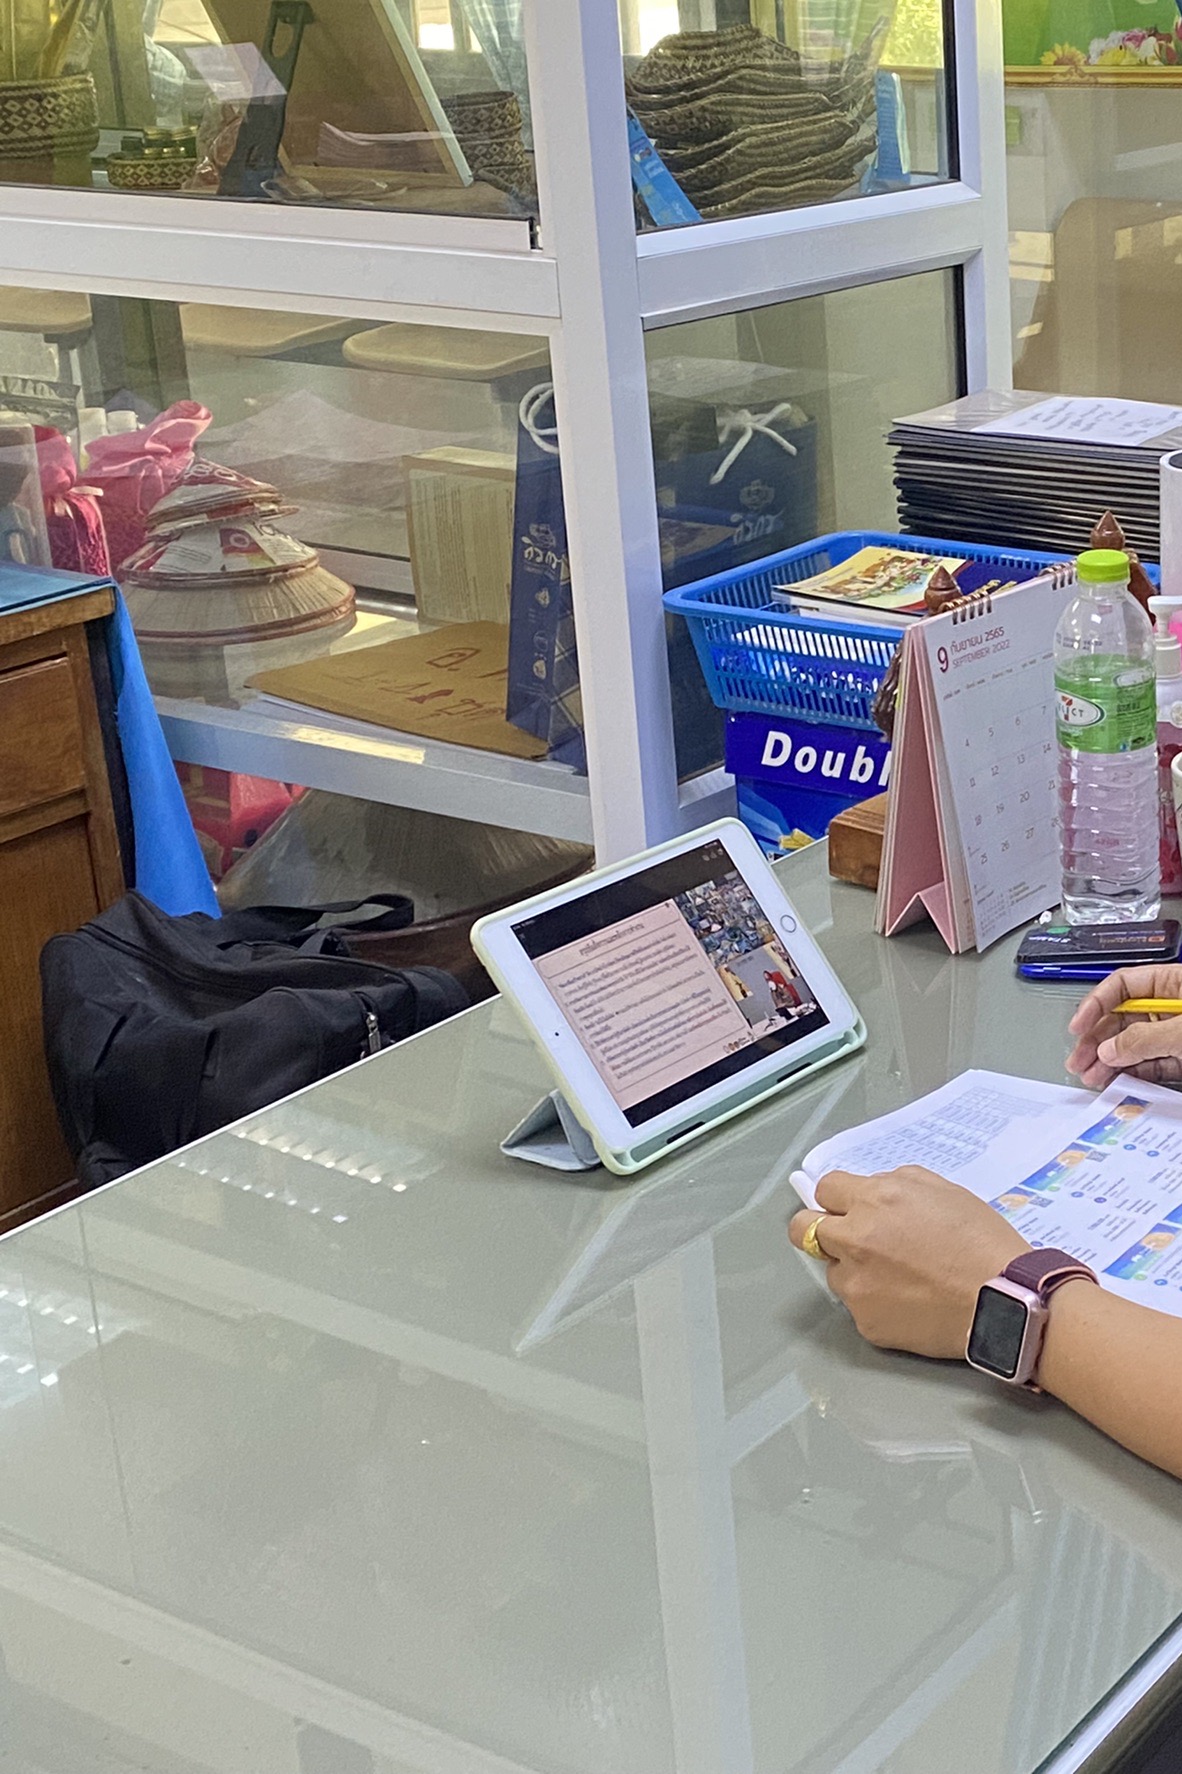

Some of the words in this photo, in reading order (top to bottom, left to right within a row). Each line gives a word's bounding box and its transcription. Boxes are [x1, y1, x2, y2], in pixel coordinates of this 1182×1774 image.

[984, 626, 1005, 644] 2565
[937, 646, 950, 674] 9
[952, 648, 991, 669] SEPTEMBER
[760, 730, 892, 787] Doubl
